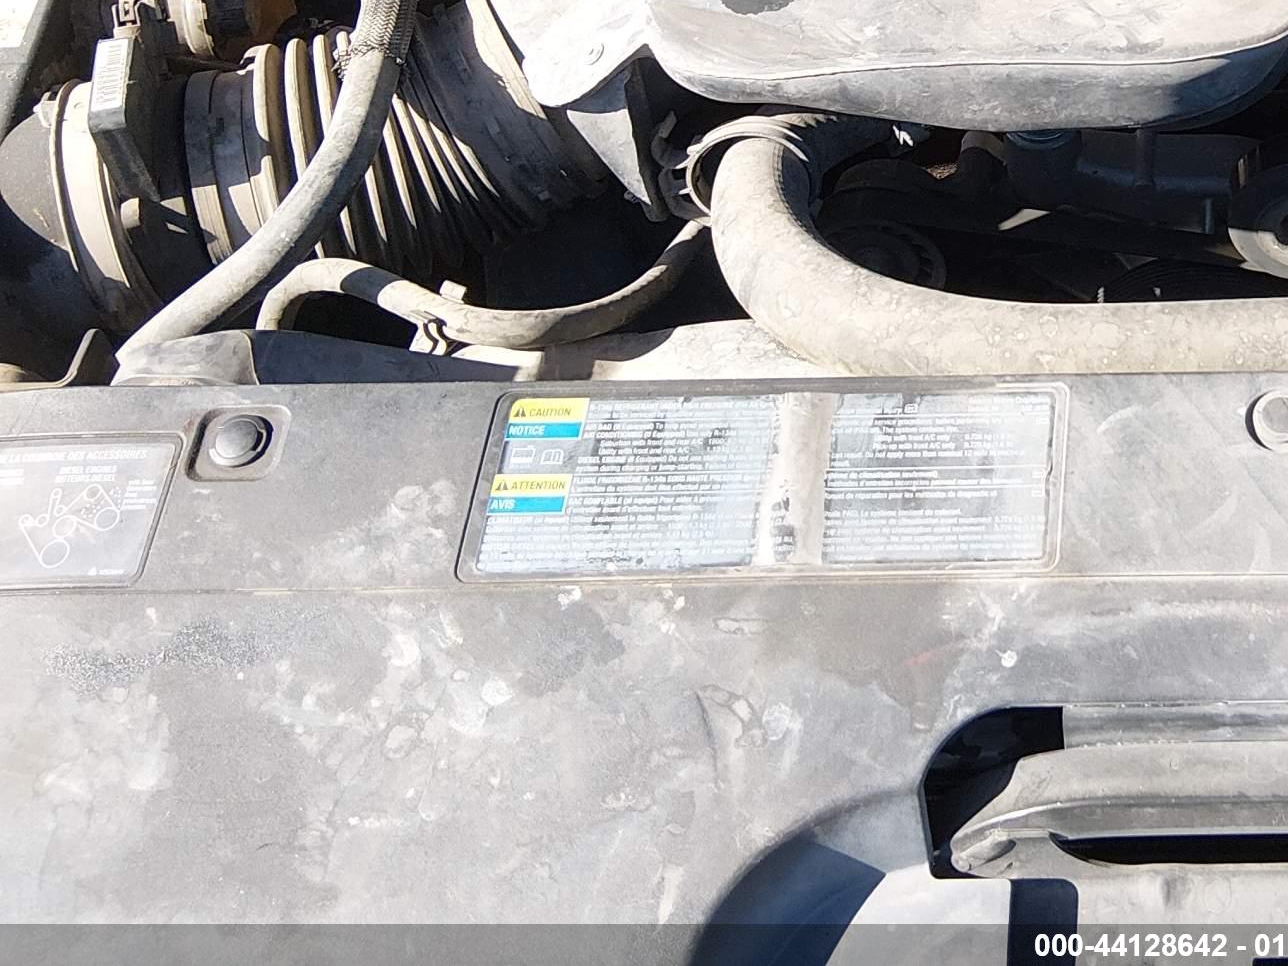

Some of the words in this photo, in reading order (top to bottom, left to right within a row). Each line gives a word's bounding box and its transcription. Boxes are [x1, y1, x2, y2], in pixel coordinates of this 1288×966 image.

[529, 408, 571, 417] CAUTION
[509, 425, 545, 434] NOTICE
[510, 481, 565, 490] ATTENTION
[490, 499, 515, 509] AVIS
